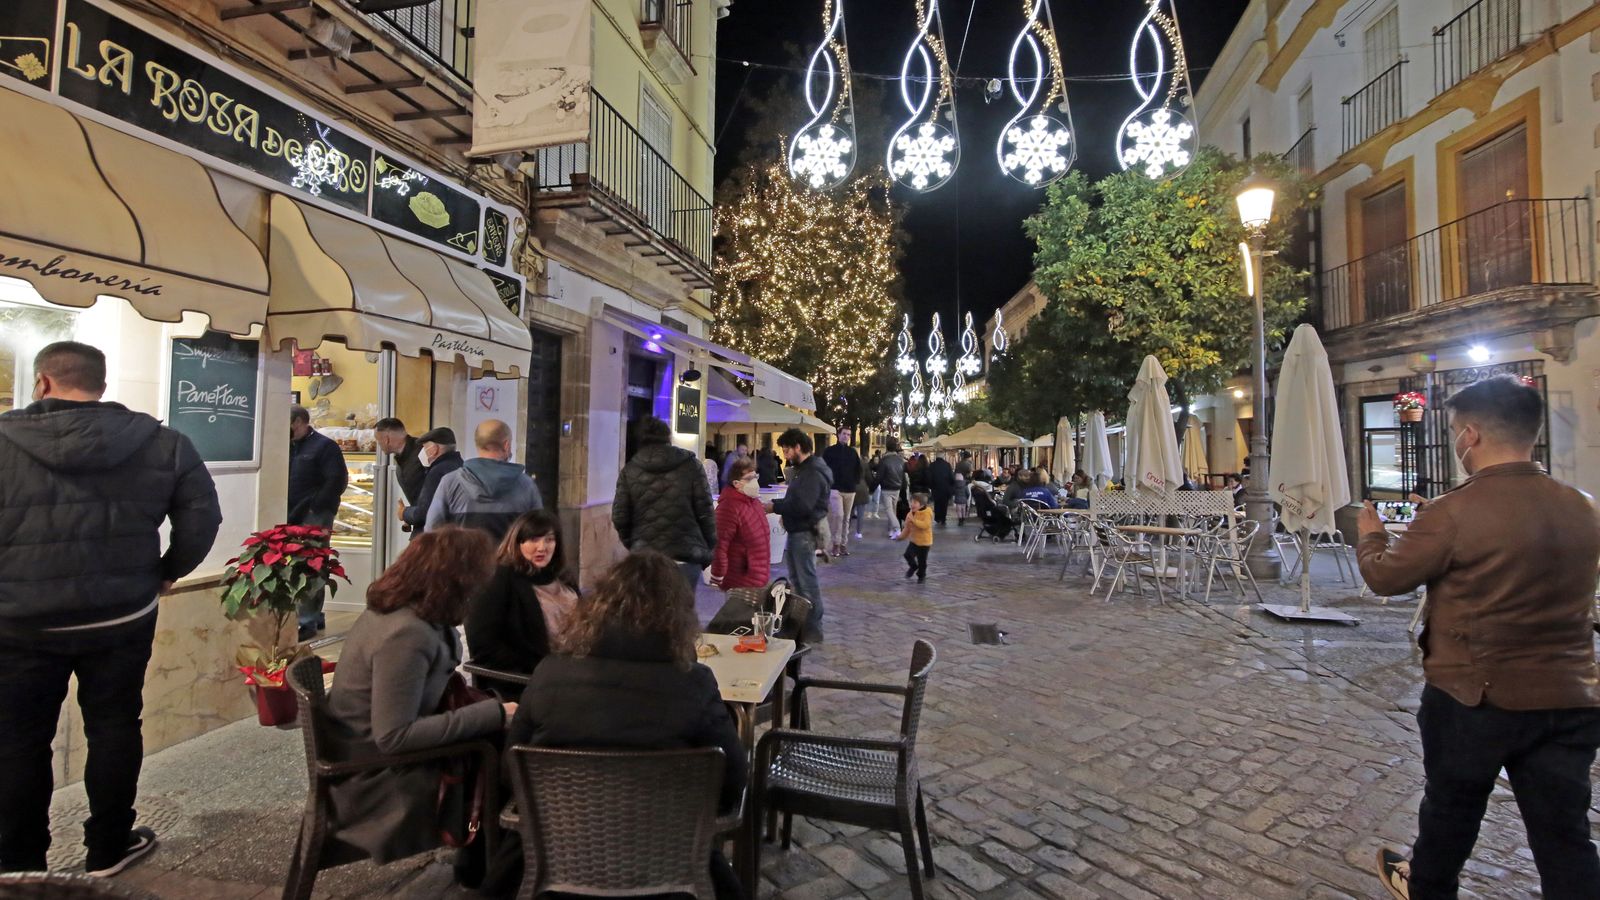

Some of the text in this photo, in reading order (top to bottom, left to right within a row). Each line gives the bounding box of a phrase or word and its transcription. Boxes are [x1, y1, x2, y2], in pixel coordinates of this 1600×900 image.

[66, 22, 134, 95] LA
[145, 61, 260, 149] ROSA
[431, 333, 485, 357] Pastelería
